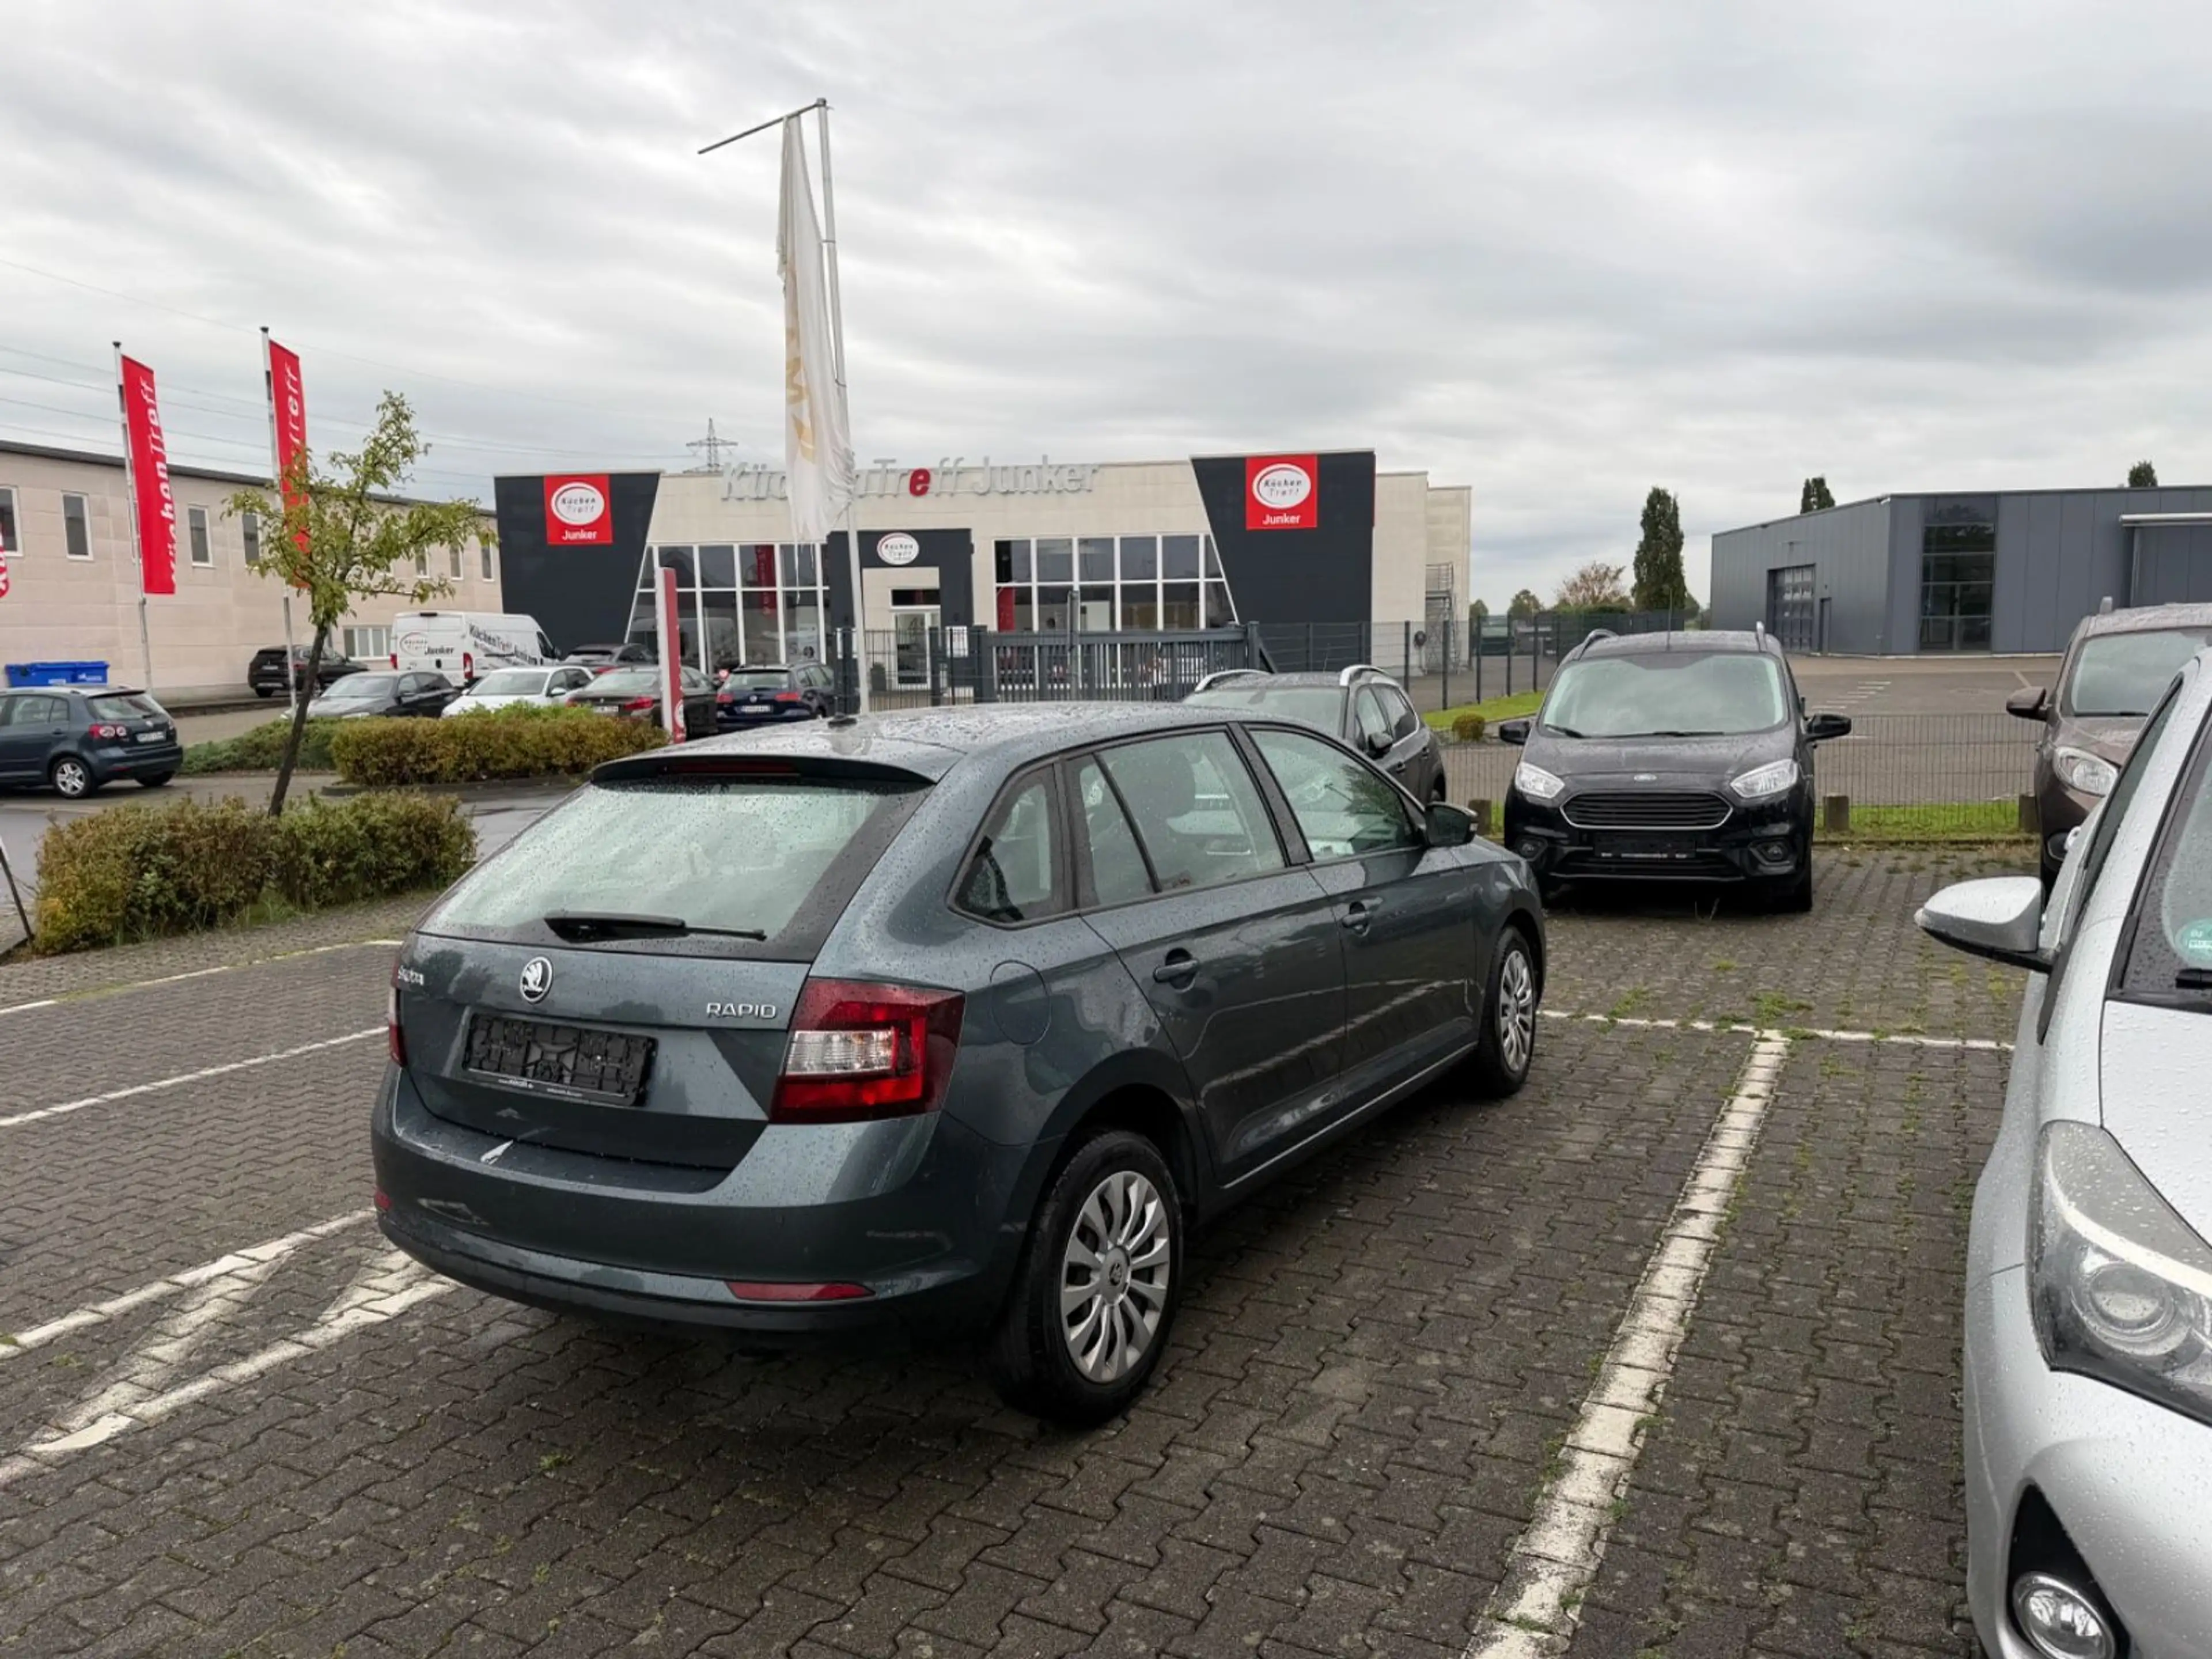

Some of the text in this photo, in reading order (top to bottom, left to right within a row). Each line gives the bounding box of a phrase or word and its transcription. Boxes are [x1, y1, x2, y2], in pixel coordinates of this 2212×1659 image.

[972, 454, 1097, 497] Junker
[1262, 512, 1301, 525] Junker
[561, 528, 598, 540] Junker
[706, 1002, 777, 1018] RAPID
